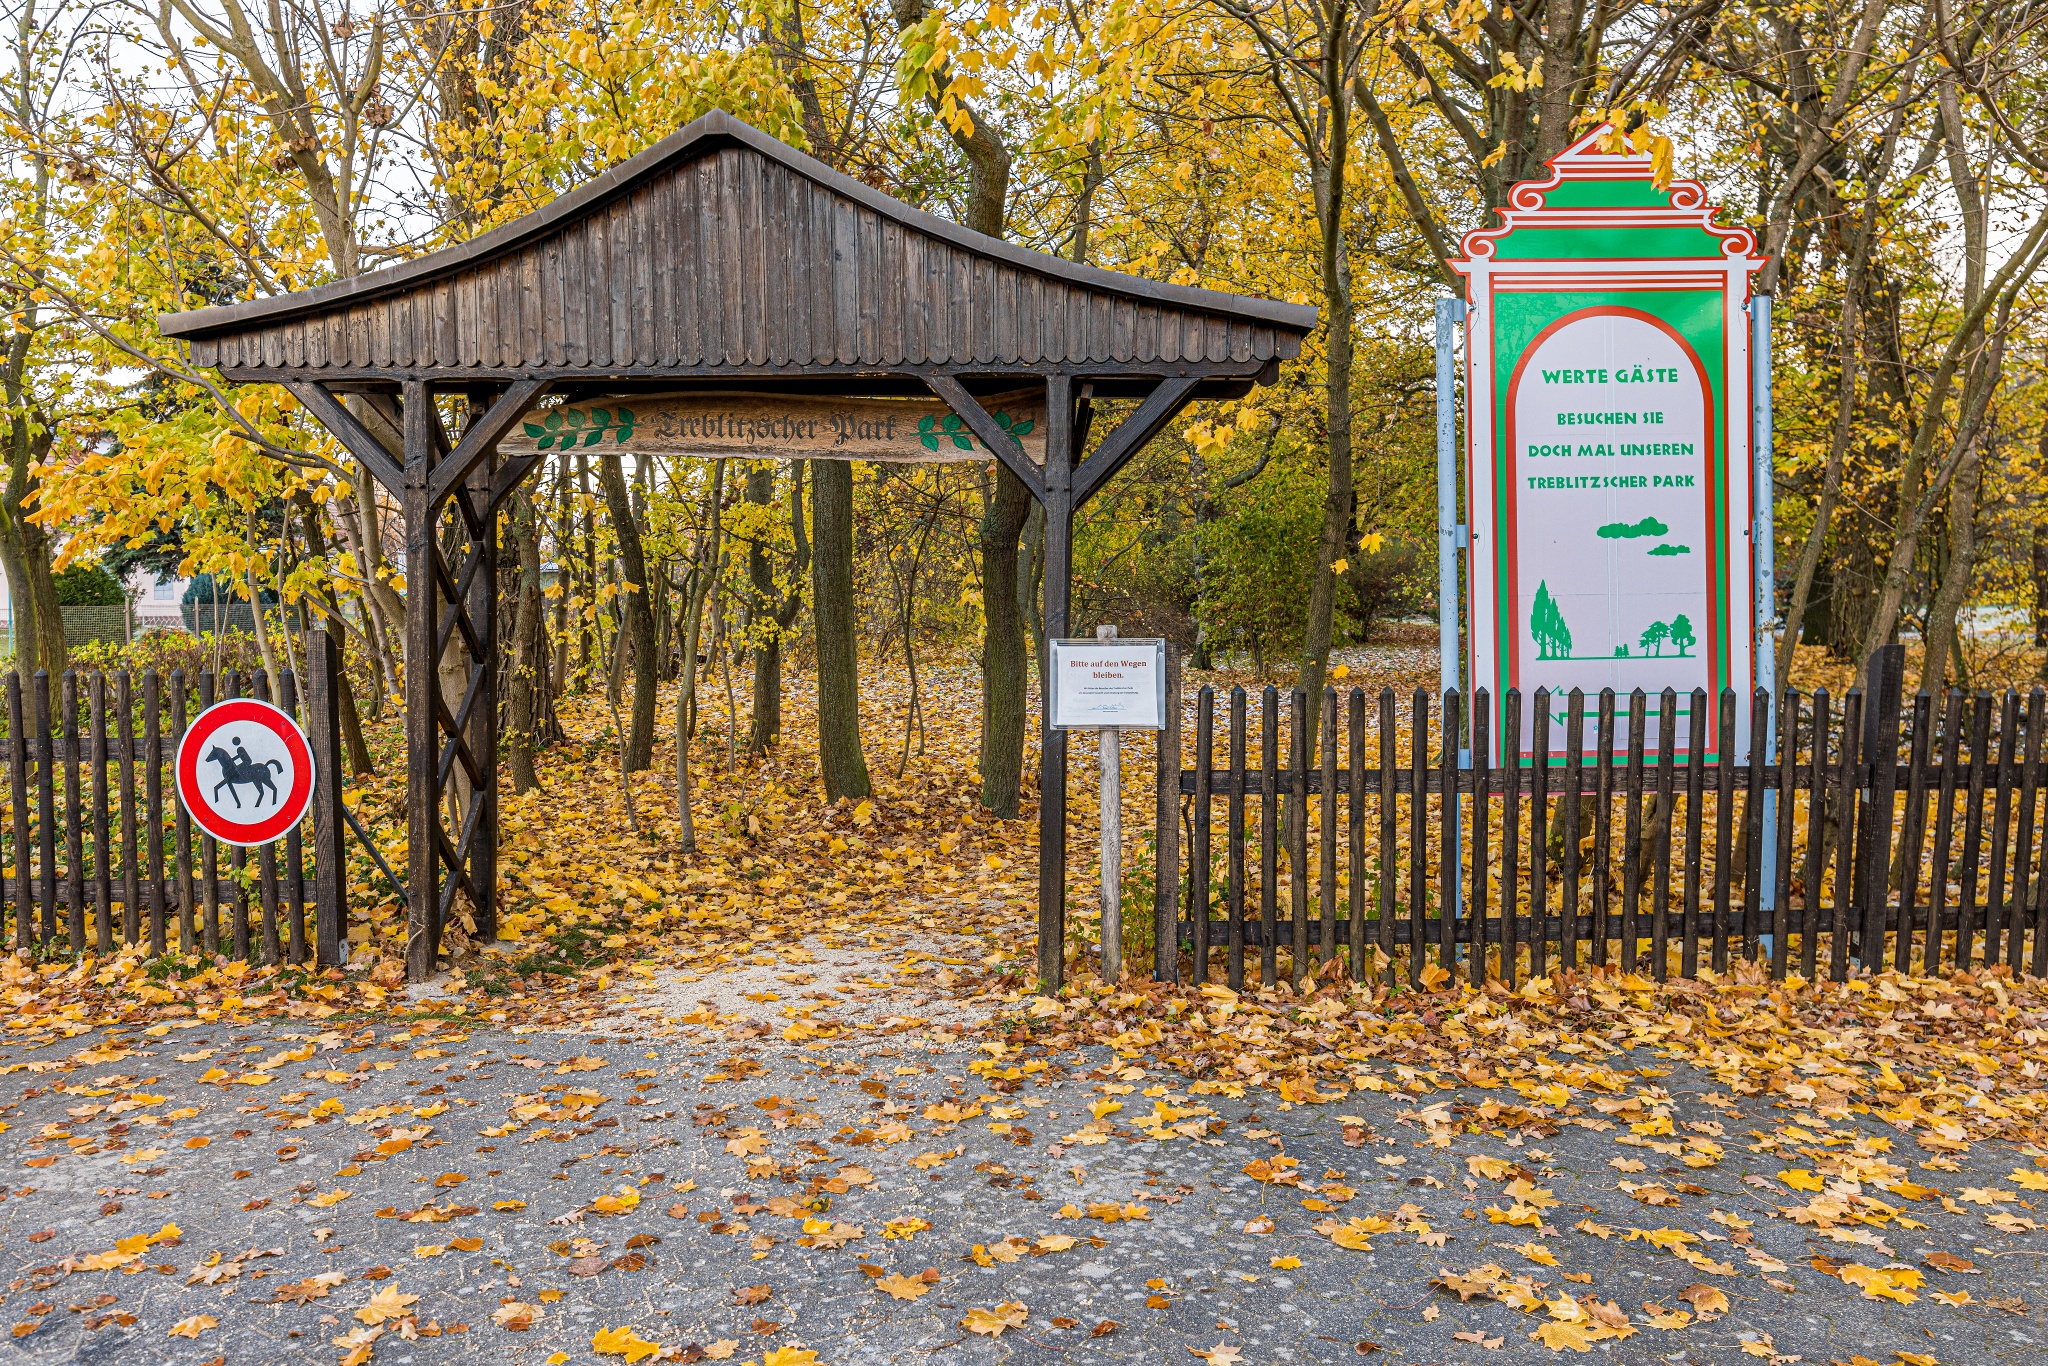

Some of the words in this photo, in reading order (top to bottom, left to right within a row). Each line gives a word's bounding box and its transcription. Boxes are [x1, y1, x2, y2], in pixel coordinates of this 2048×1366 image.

[1542, 369, 1608, 384] WERTE
[1615, 364, 1678, 383] GÄSTE
[1557, 412, 1637, 425] BESUCHEN
[1643, 411, 1664, 424] SIE
[654, 411, 819, 445] Treblitzscher
[829, 412, 897, 446] Park
[1528, 444, 1572, 457] DOCH
[1577, 444, 1615, 457] MAL
[1620, 443, 1694, 456] UNSEREN
[1528, 476, 1648, 489] TREBLITZSCHER
[1653, 475, 1695, 488] PARK
[1070, 660, 1089, 668] Bitte
[1090, 660, 1104, 668] auf
[1104, 660, 1119, 668] den
[1120, 660, 1147, 669] Wegen
[1093, 671, 1124, 679] bleiben.
